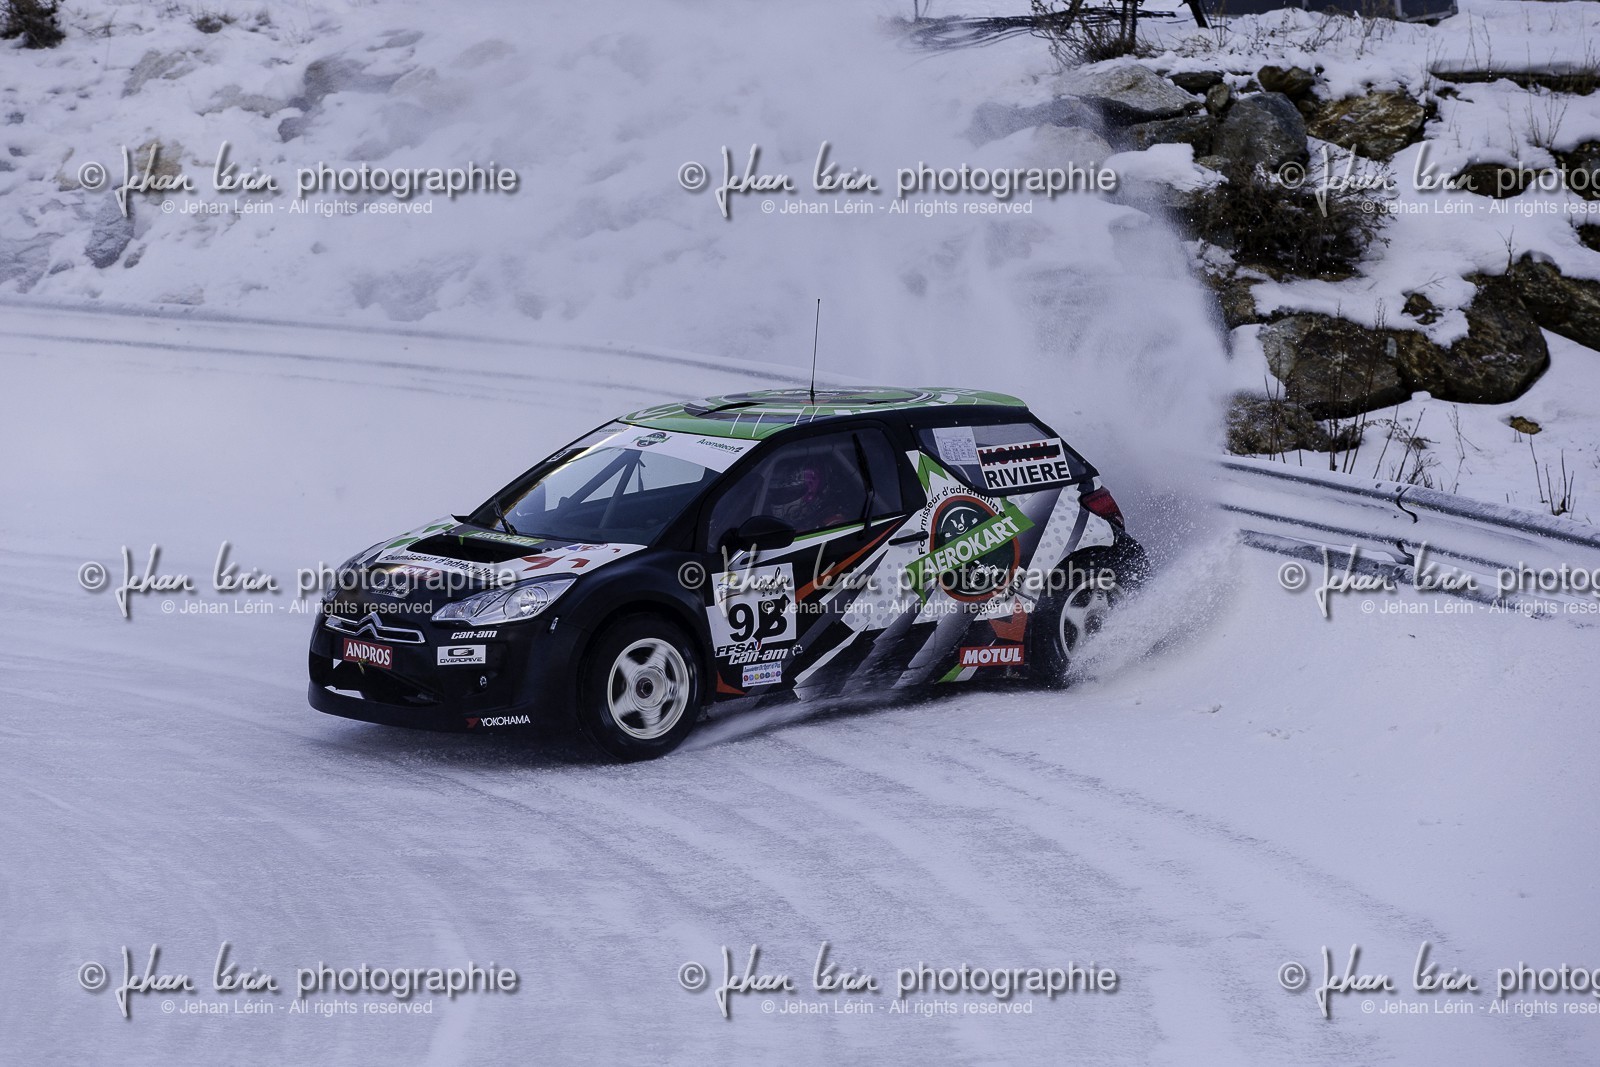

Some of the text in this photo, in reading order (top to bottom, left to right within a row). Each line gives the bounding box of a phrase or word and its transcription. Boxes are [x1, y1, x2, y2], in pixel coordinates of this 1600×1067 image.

[697, 438, 736, 452] Aromatech
[984, 461, 1069, 488] RIVIERE
[918, 493, 941, 555] Fornisseur
[923, 516, 1020, 580] AEROKART
[451, 630, 497, 640] can-am
[345, 642, 391, 667] ANDROS
[716, 642, 757, 656] FFSA
[729, 648, 788, 665] can-am
[962, 648, 1021, 665] MOTUL
[480, 714, 531, 727] YOKOHAMA
